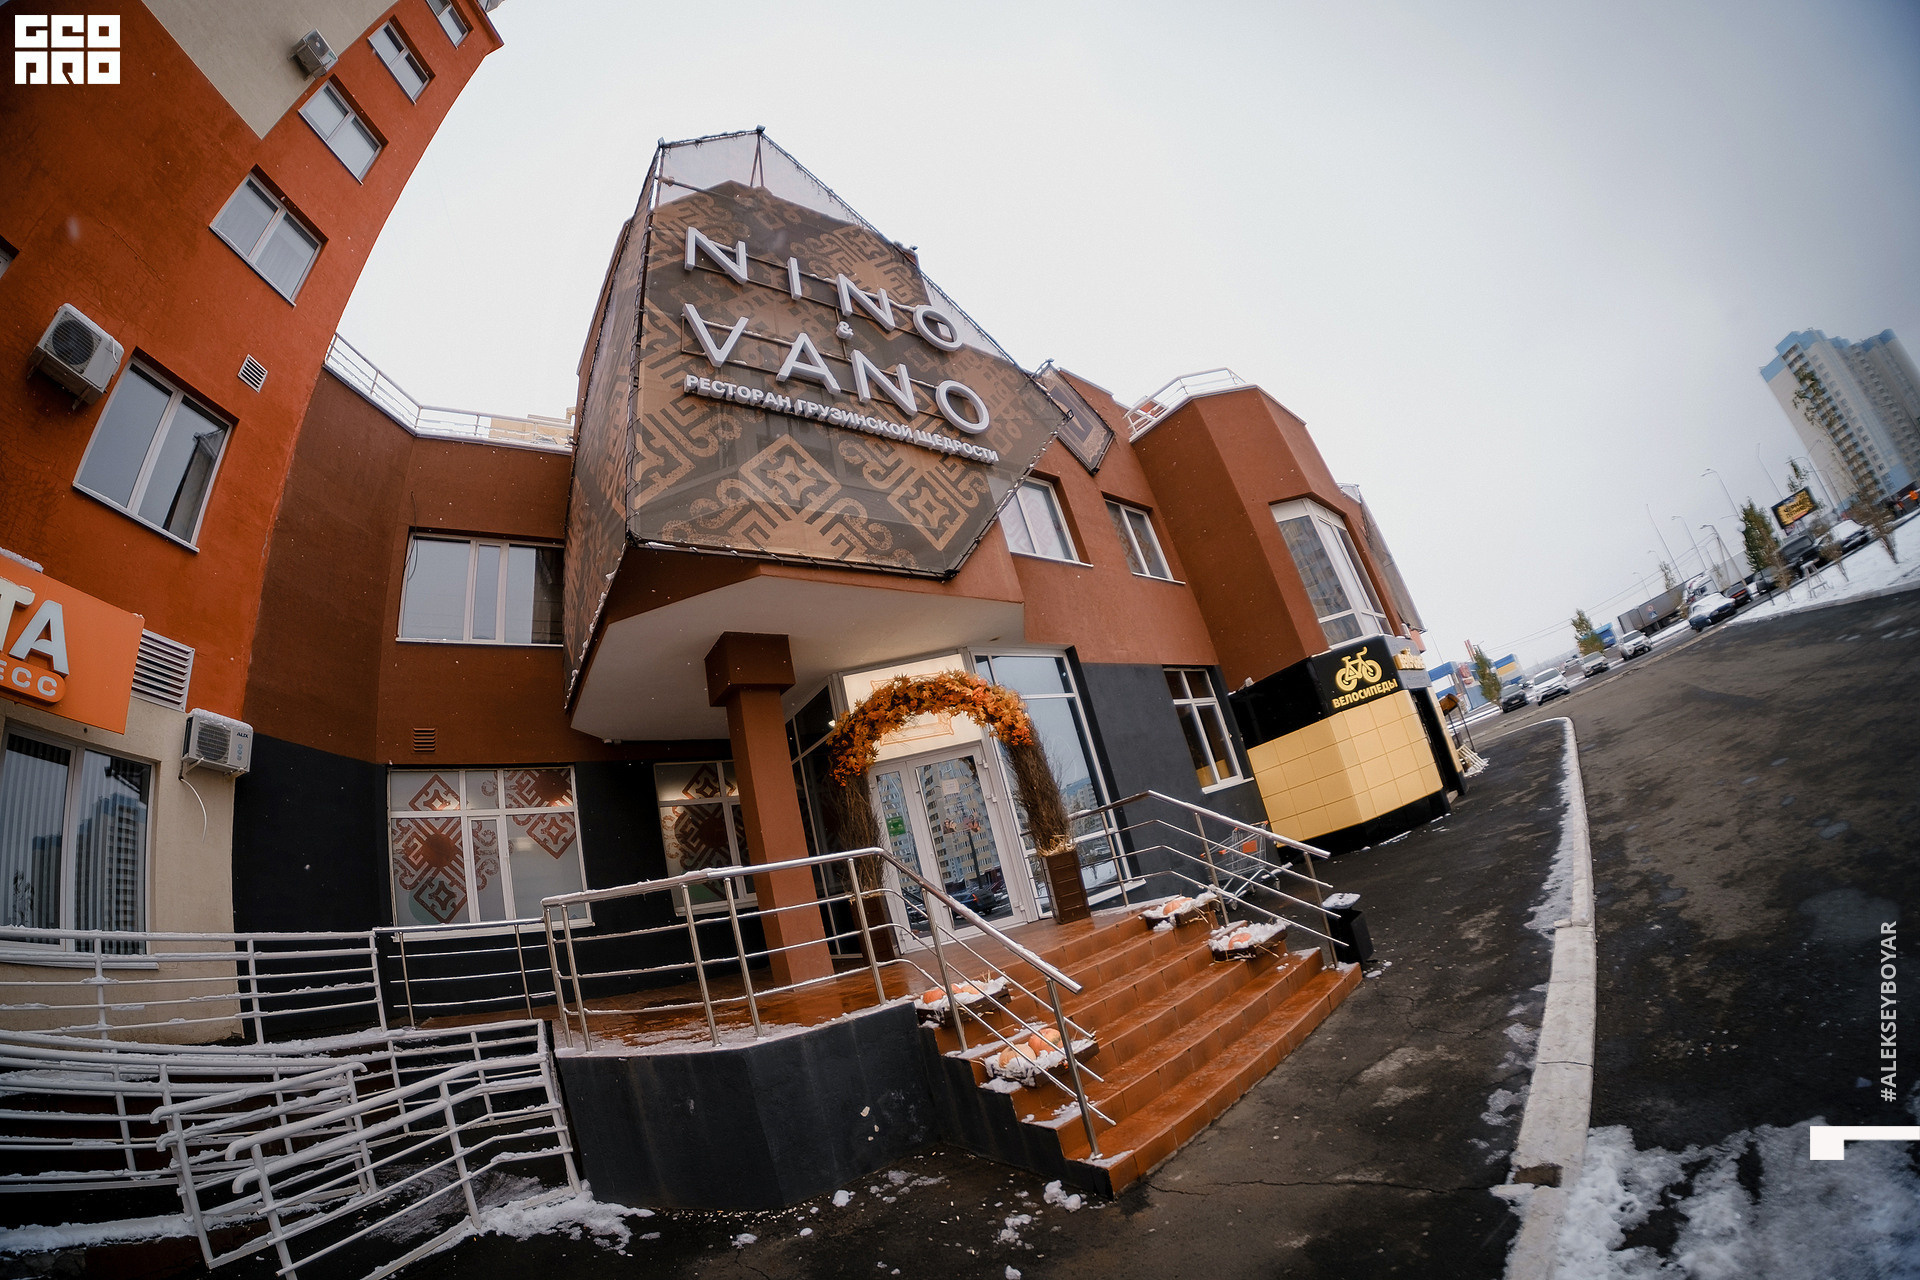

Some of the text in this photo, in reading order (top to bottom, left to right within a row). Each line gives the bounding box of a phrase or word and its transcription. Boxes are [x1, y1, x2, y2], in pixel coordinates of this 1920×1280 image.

[684, 226, 964, 352] NINO
[835, 319, 855, 341] &
[682, 302, 990, 434] VANO
[684, 374, 1000, 465] РЕСТОРАН ГРУЗИНСКОЙ ЩЕДРОСТИ
[1332, 678, 1398, 708] ВЕЛОСИПЕДЫ
